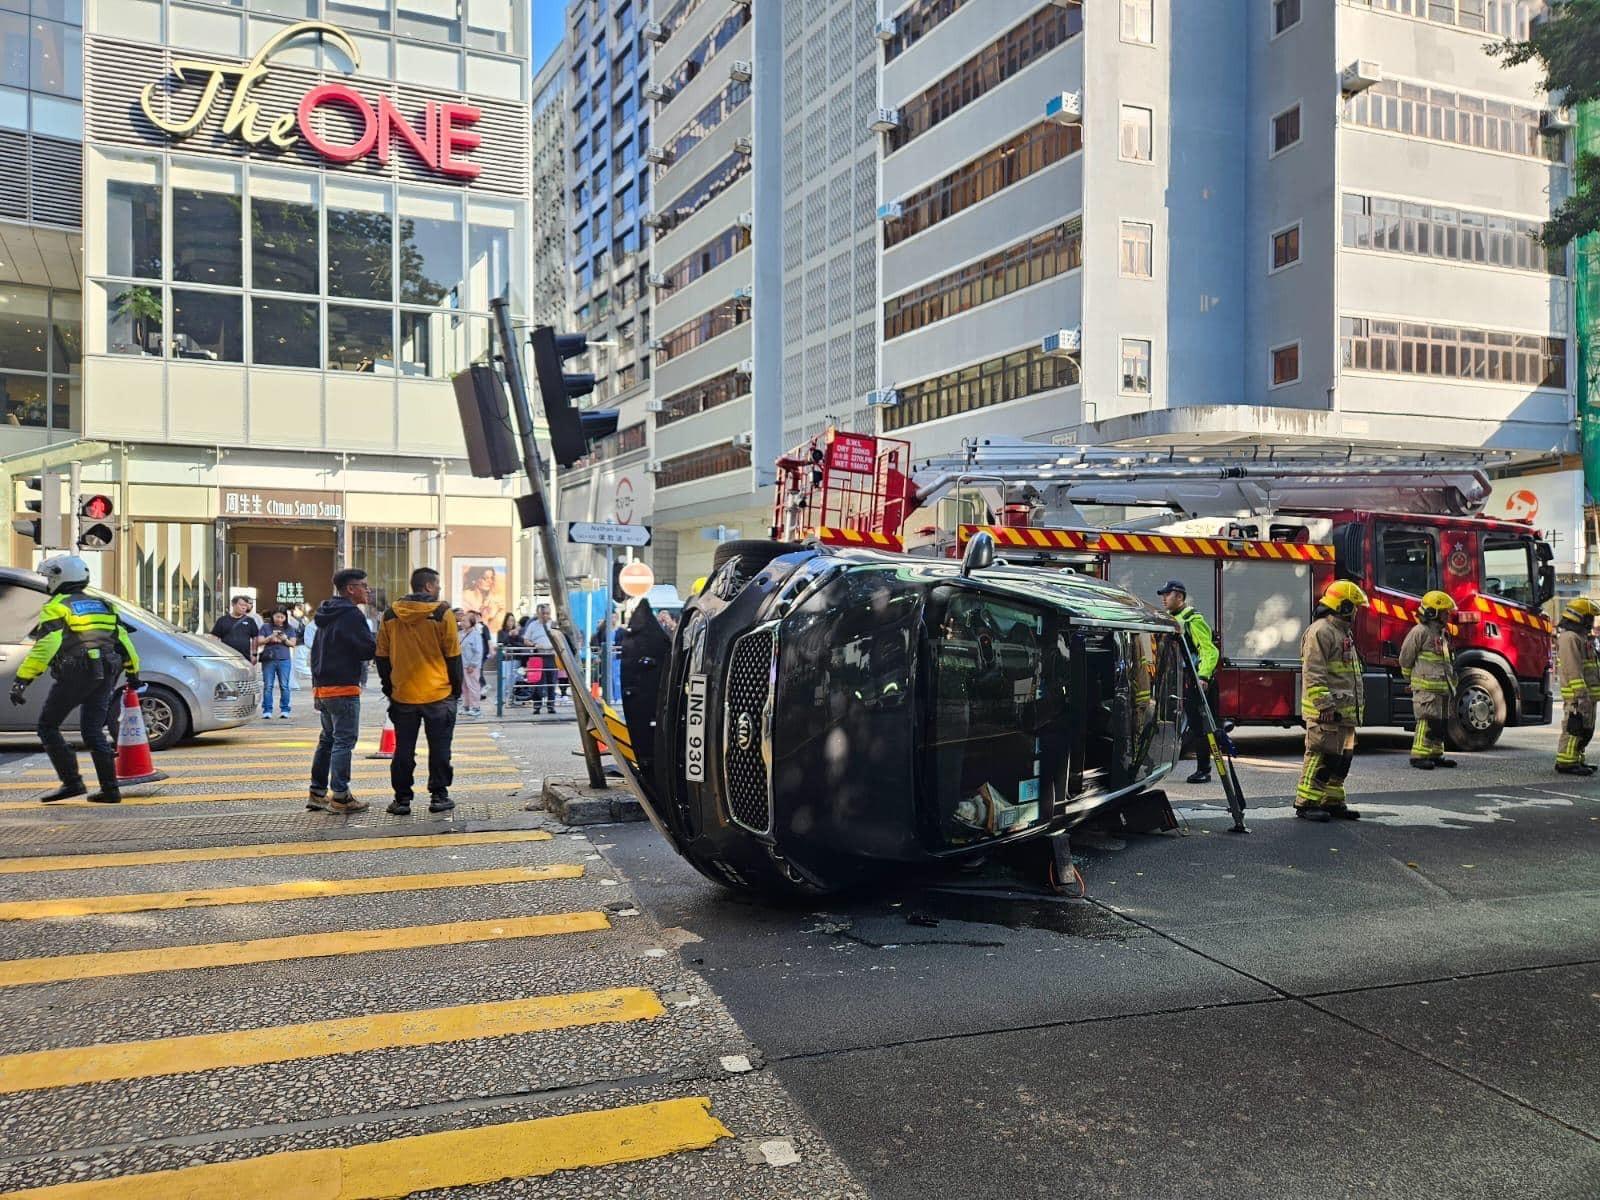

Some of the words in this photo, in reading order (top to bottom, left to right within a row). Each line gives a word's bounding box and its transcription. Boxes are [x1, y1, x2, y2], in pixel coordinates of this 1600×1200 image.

[141, 21, 361, 147] The
[298, 83, 481, 178] ONE
[225, 493, 263, 515] 周生生
[266, 499, 293, 516] Chow
[294, 500, 318, 519] Sang
[318, 501, 342, 520] Sang
[277, 581, 305, 598] 周生生
[690, 679, 705, 727] LING
[738, 720, 749, 744] KIA
[688, 736, 703, 776] 930
